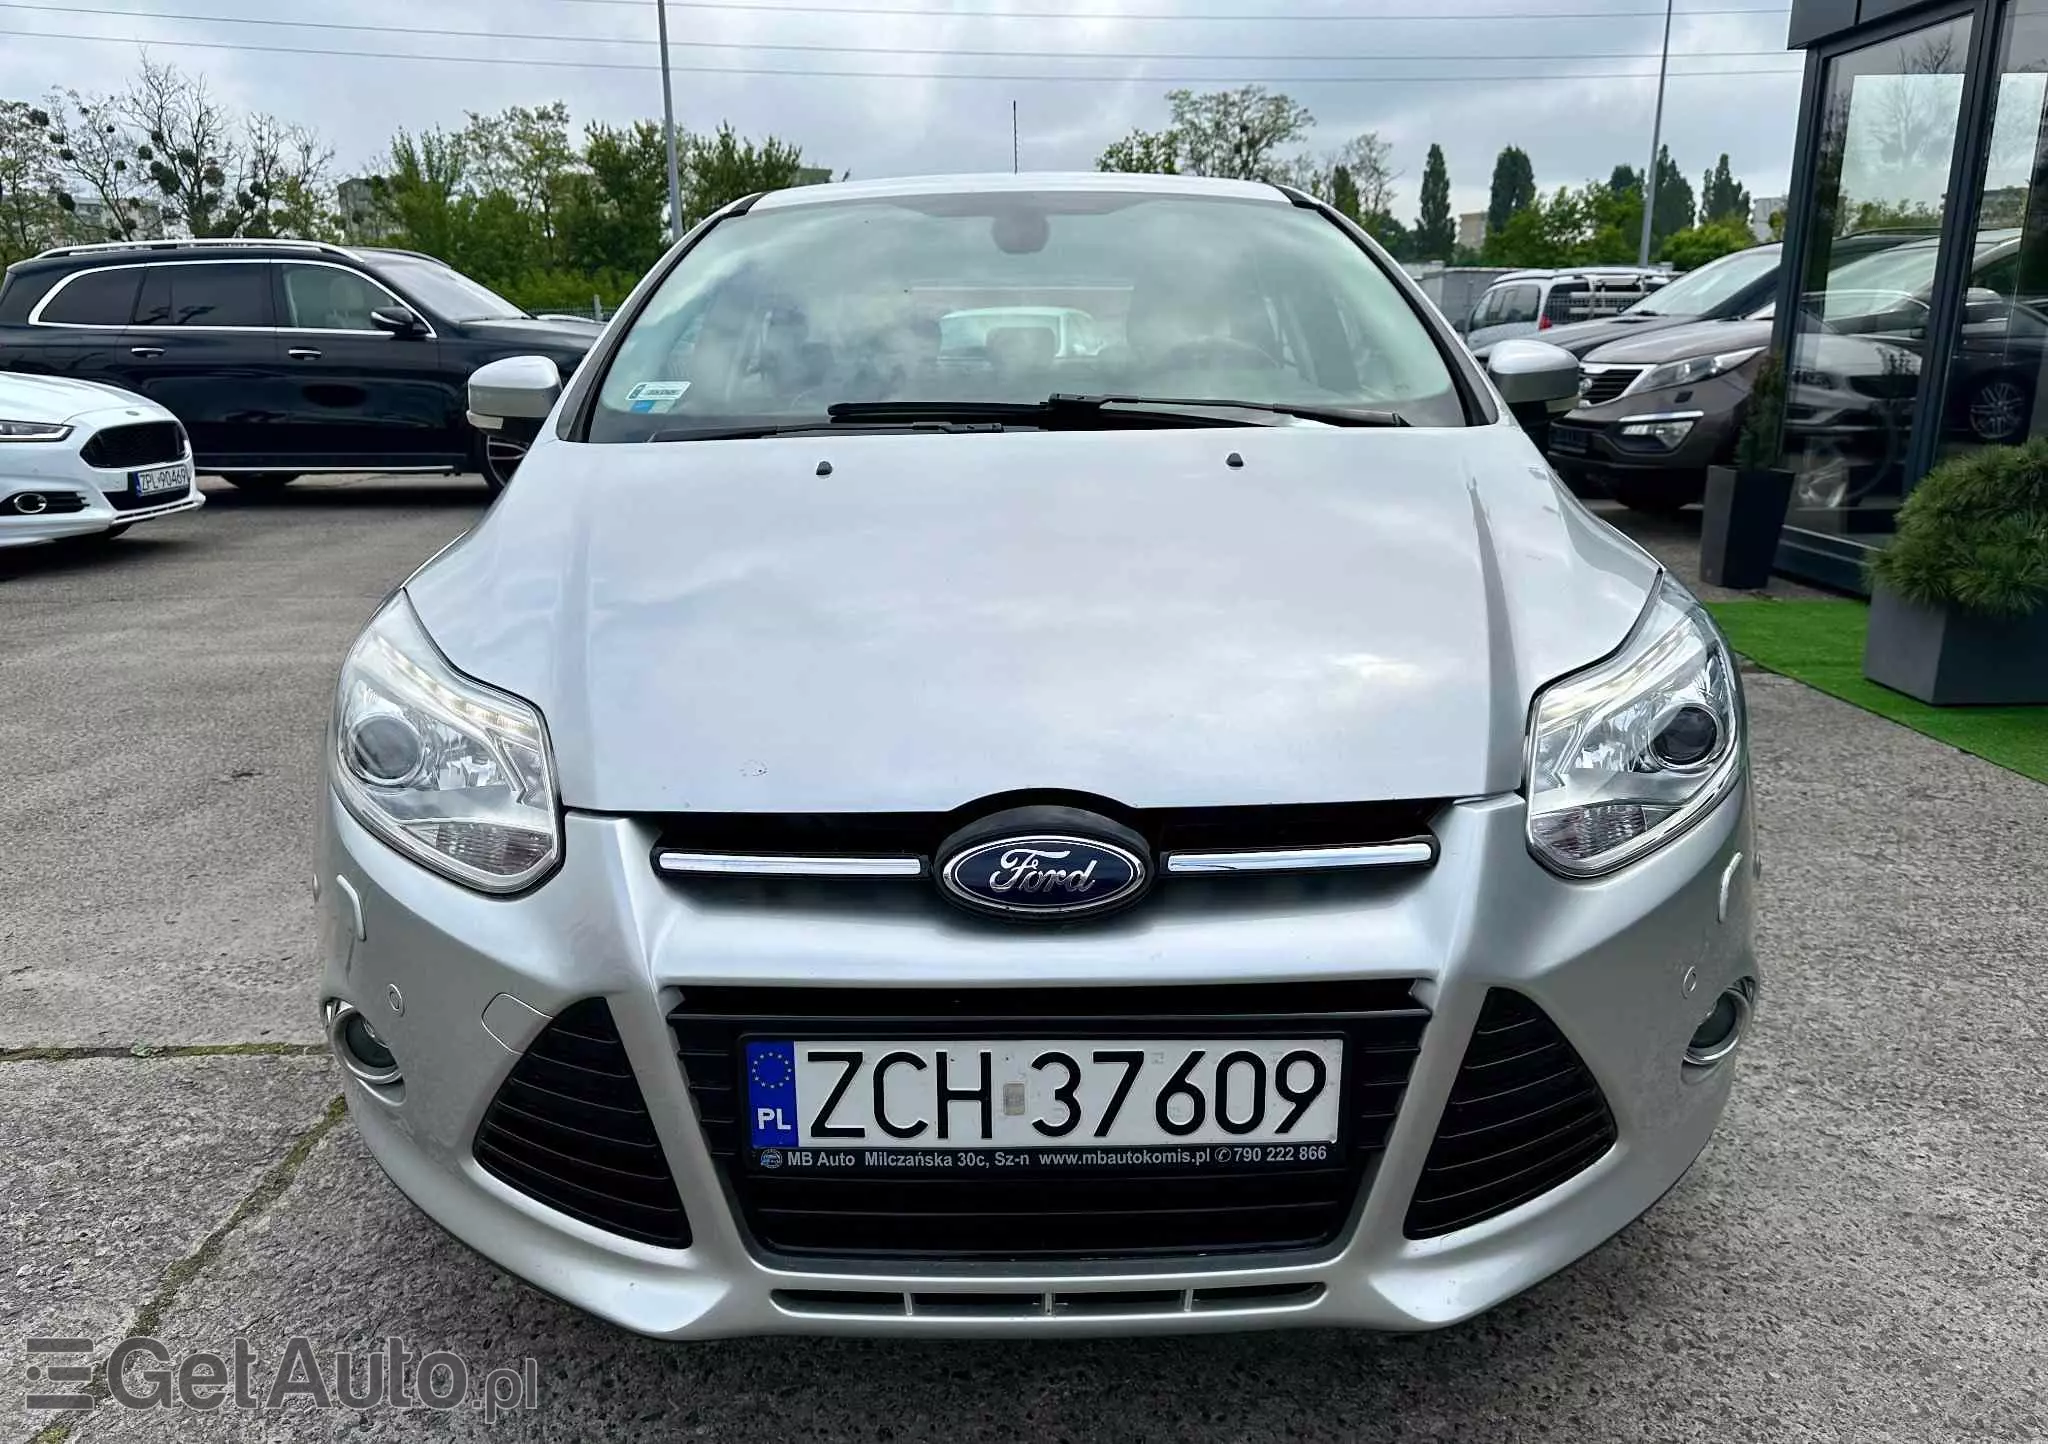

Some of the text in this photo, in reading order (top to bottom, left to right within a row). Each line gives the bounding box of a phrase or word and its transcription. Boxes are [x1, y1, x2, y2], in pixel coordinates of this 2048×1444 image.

[989, 848, 1098, 893] Ford
[807, 1049, 1327, 1139] ZCH 37609
[757, 1108, 792, 1131] PL
[787, 1145, 1327, 1168] MB Auto Milczańska 30c, Sz-n www.mbautokomis.pl 790 222 866
